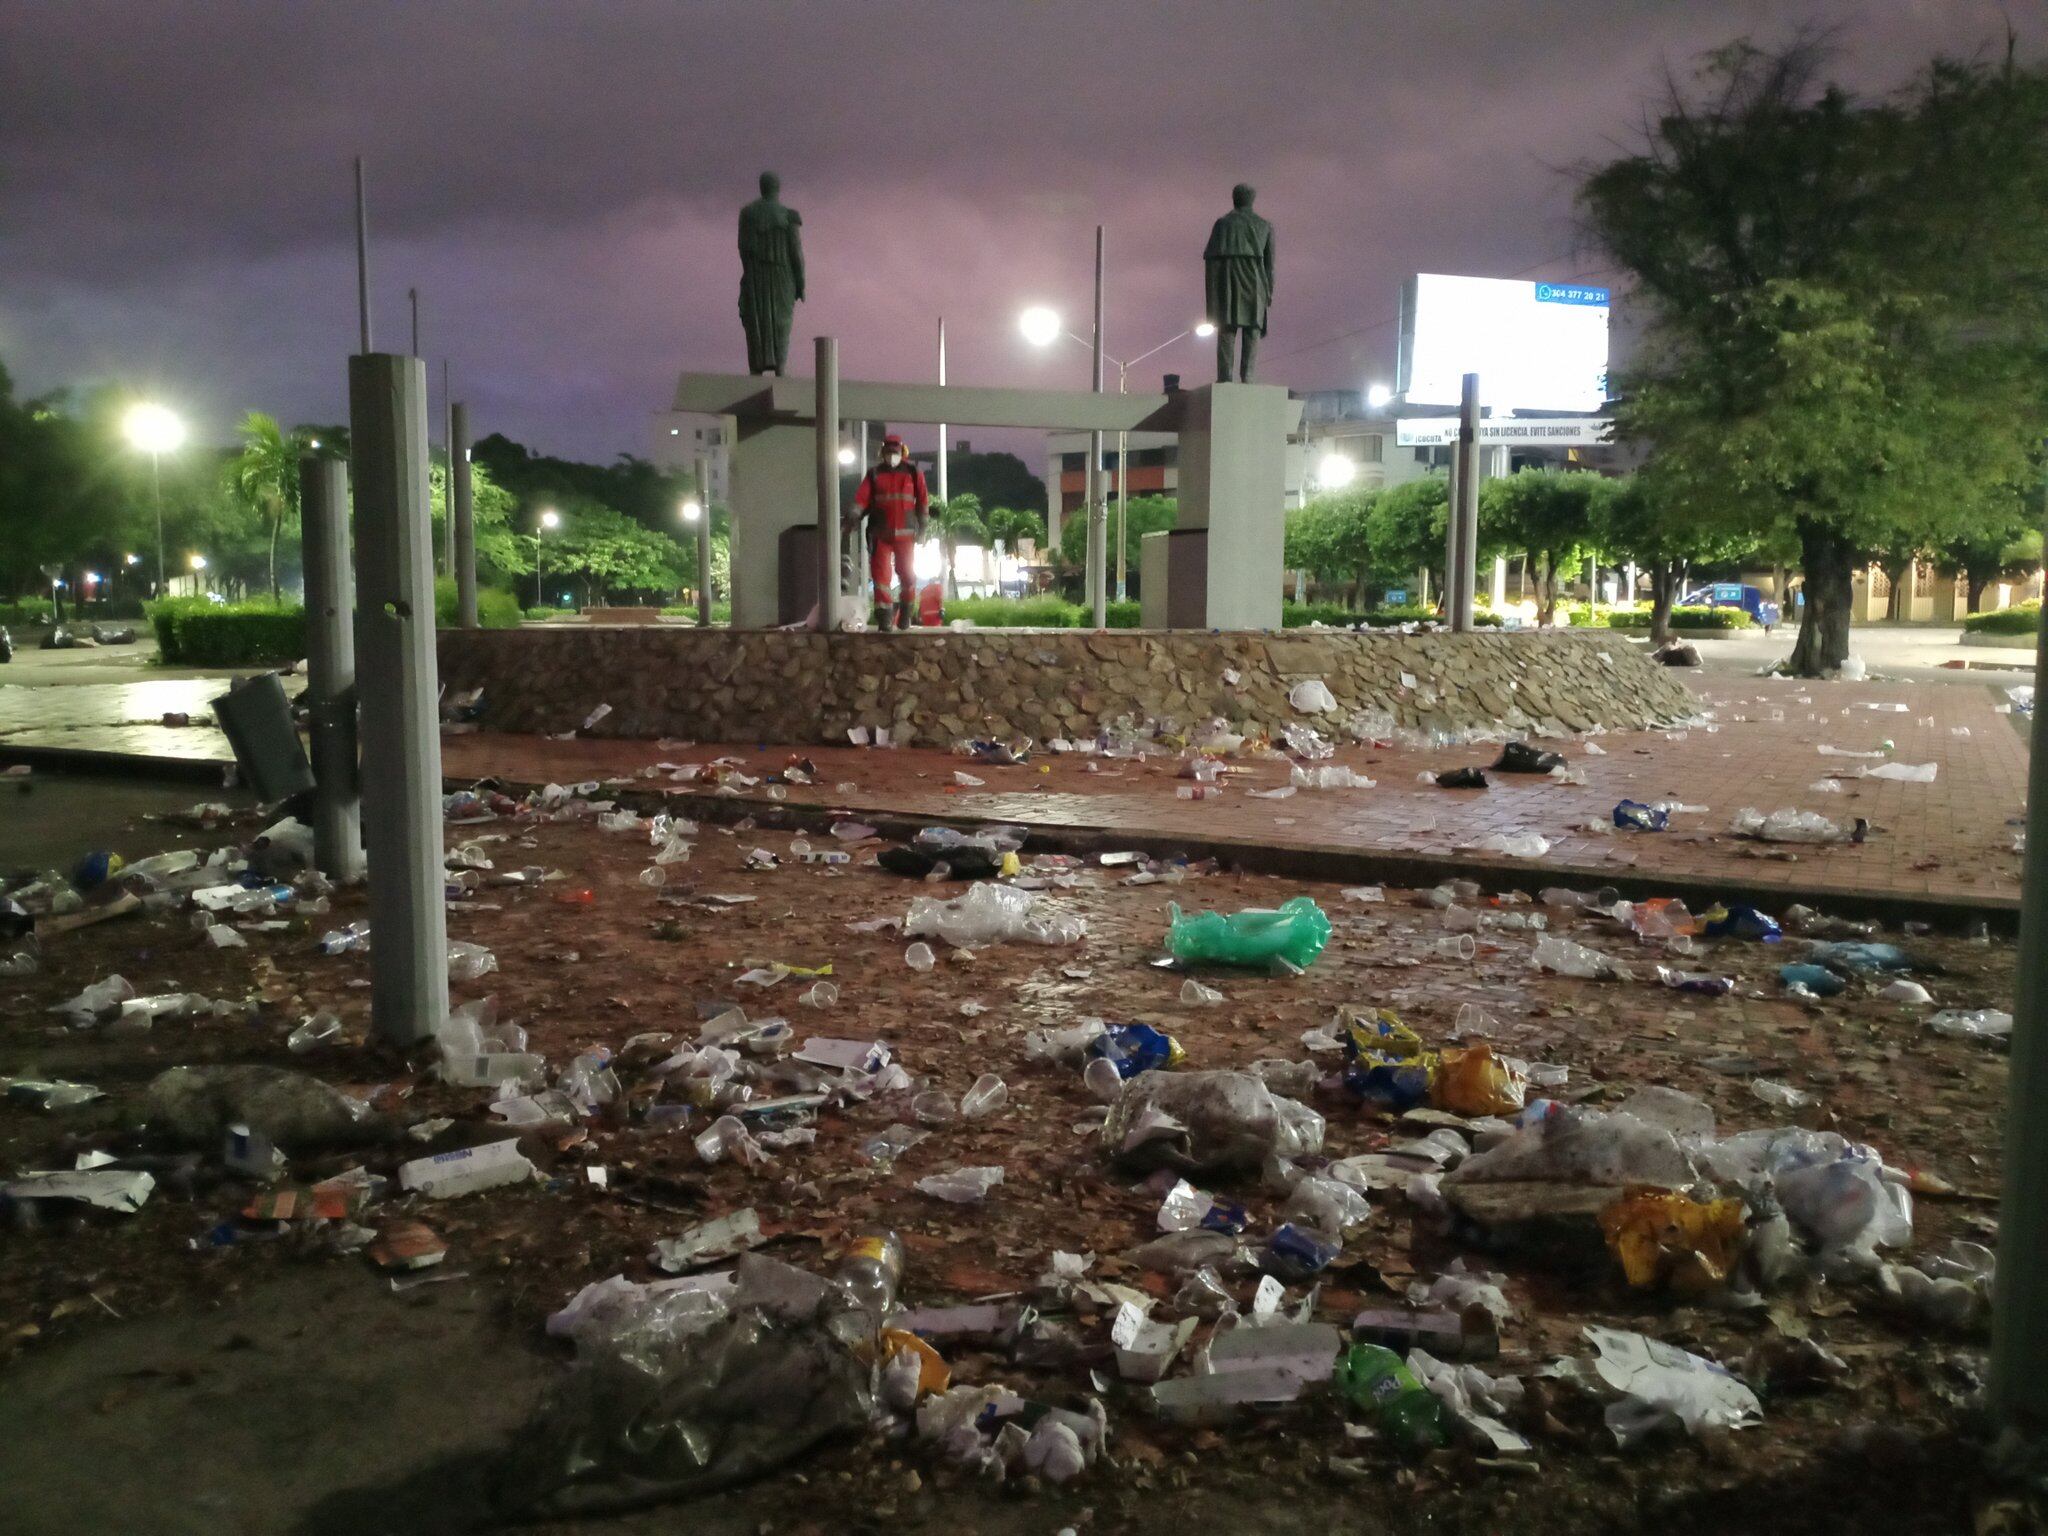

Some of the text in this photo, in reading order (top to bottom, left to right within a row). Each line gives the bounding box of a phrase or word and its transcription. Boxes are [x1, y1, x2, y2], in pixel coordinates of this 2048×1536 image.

[1567, 290, 1582, 299] 377
[1489, 427, 1500, 437] SIN
[1530, 426, 1547, 437] EVITE
[1547, 426, 1581, 437] SANCIONES
